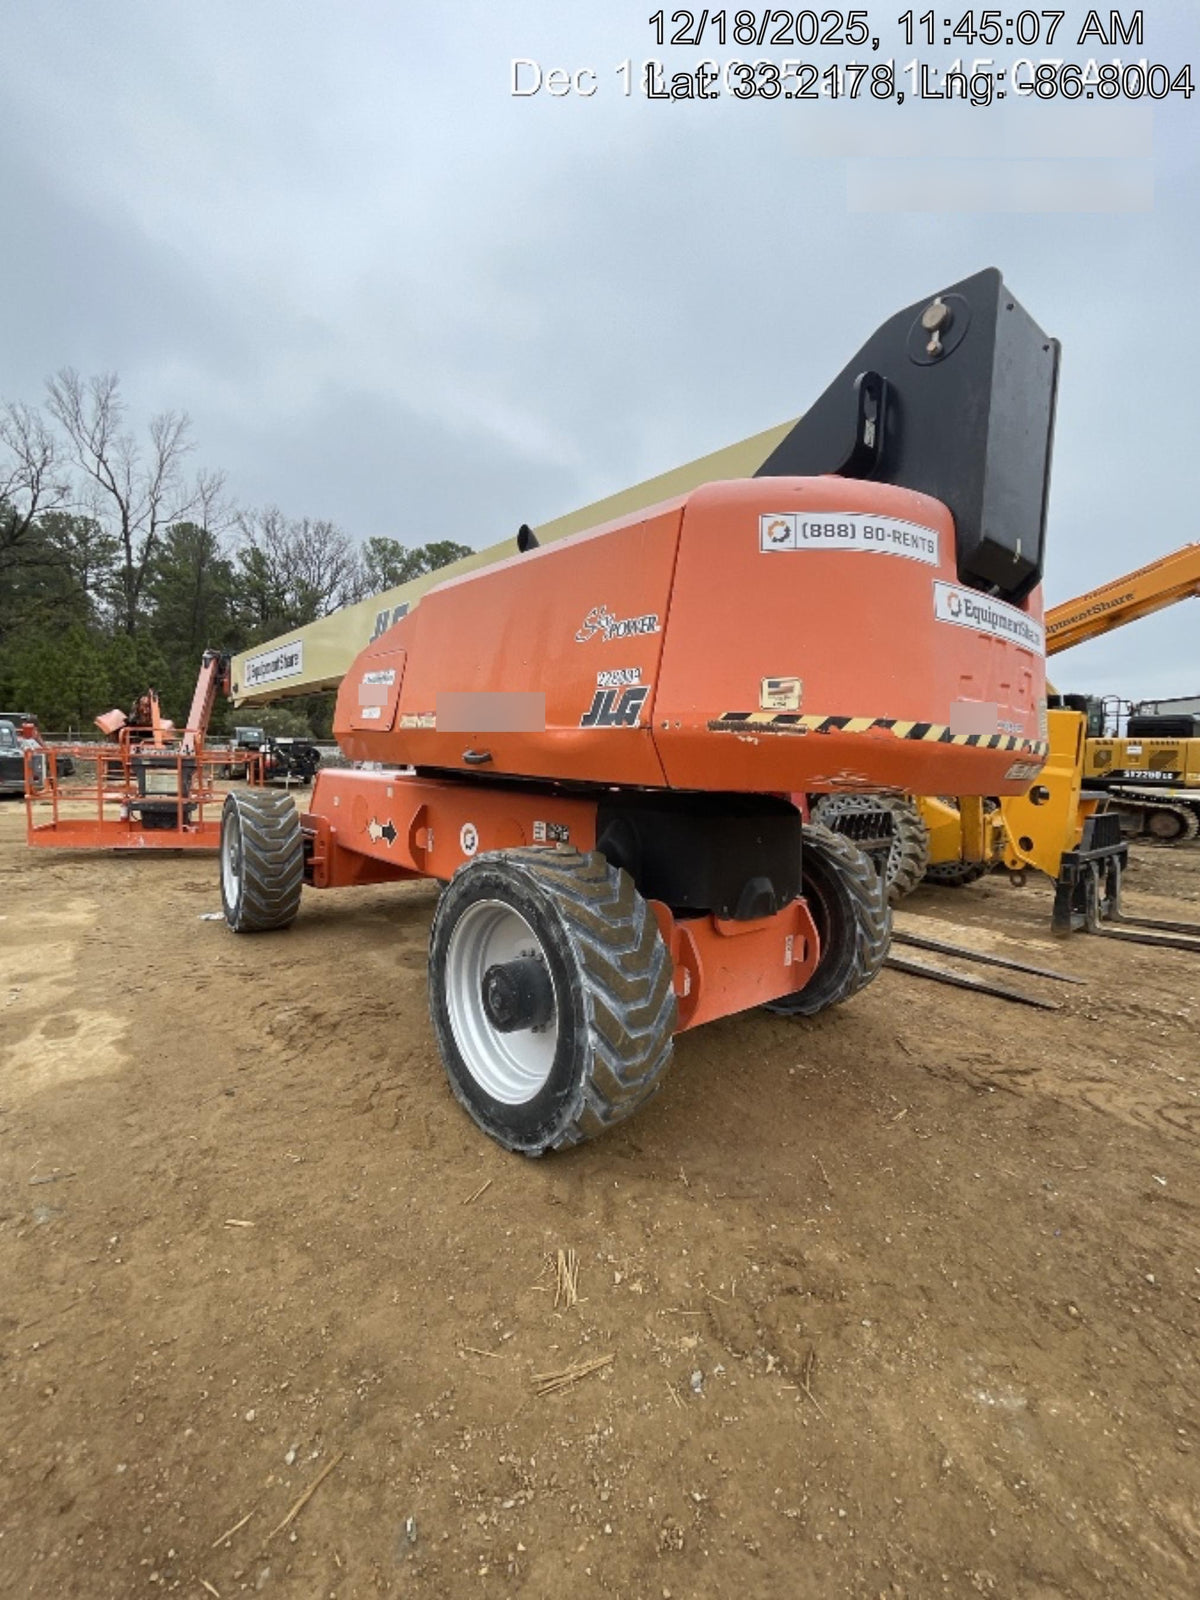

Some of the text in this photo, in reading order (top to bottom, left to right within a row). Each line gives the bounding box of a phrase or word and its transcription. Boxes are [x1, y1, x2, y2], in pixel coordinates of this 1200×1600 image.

[802, 522, 935, 554] (888) 80-RENTS
[579, 685, 651, 729] JLG
